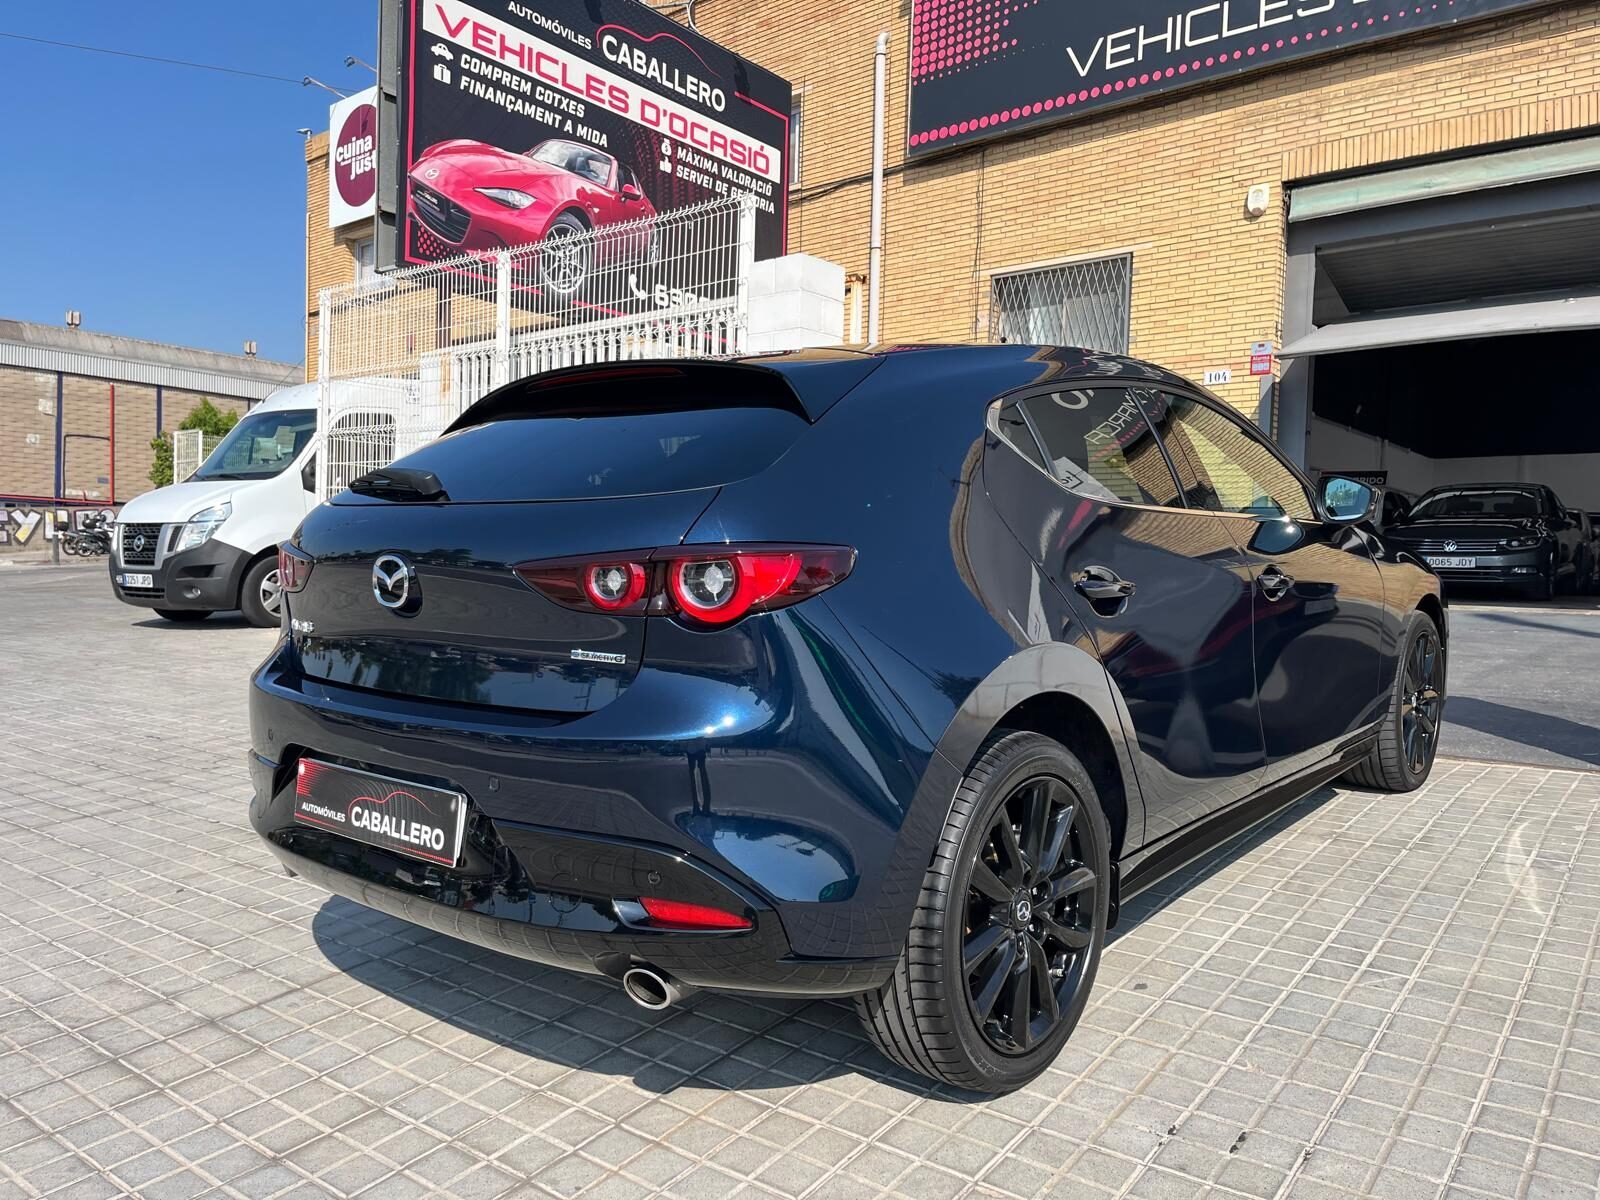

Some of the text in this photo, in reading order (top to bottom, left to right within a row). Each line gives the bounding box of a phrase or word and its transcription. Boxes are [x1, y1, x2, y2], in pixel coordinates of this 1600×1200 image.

[508, 1, 726, 112] AUTOMÓVILES CABALLERO
[435, 3, 770, 175] VEHICLES D'OCASIÓ
[460, 53, 585, 118] COMPREM COTXES
[460, 75, 608, 149] FINANÇAMENT A MIDA
[336, 134, 373, 163] cuina
[677, 146, 772, 197] MÀXIMA VALORACIÓ
[676, 165, 775, 214] SERVEI DE GEORIA
[1208, 371, 1228, 383] 104
[1455, 558, 1473, 567] JDY
[301, 801, 445, 850] AUTOMÓVILES CABALLERO
